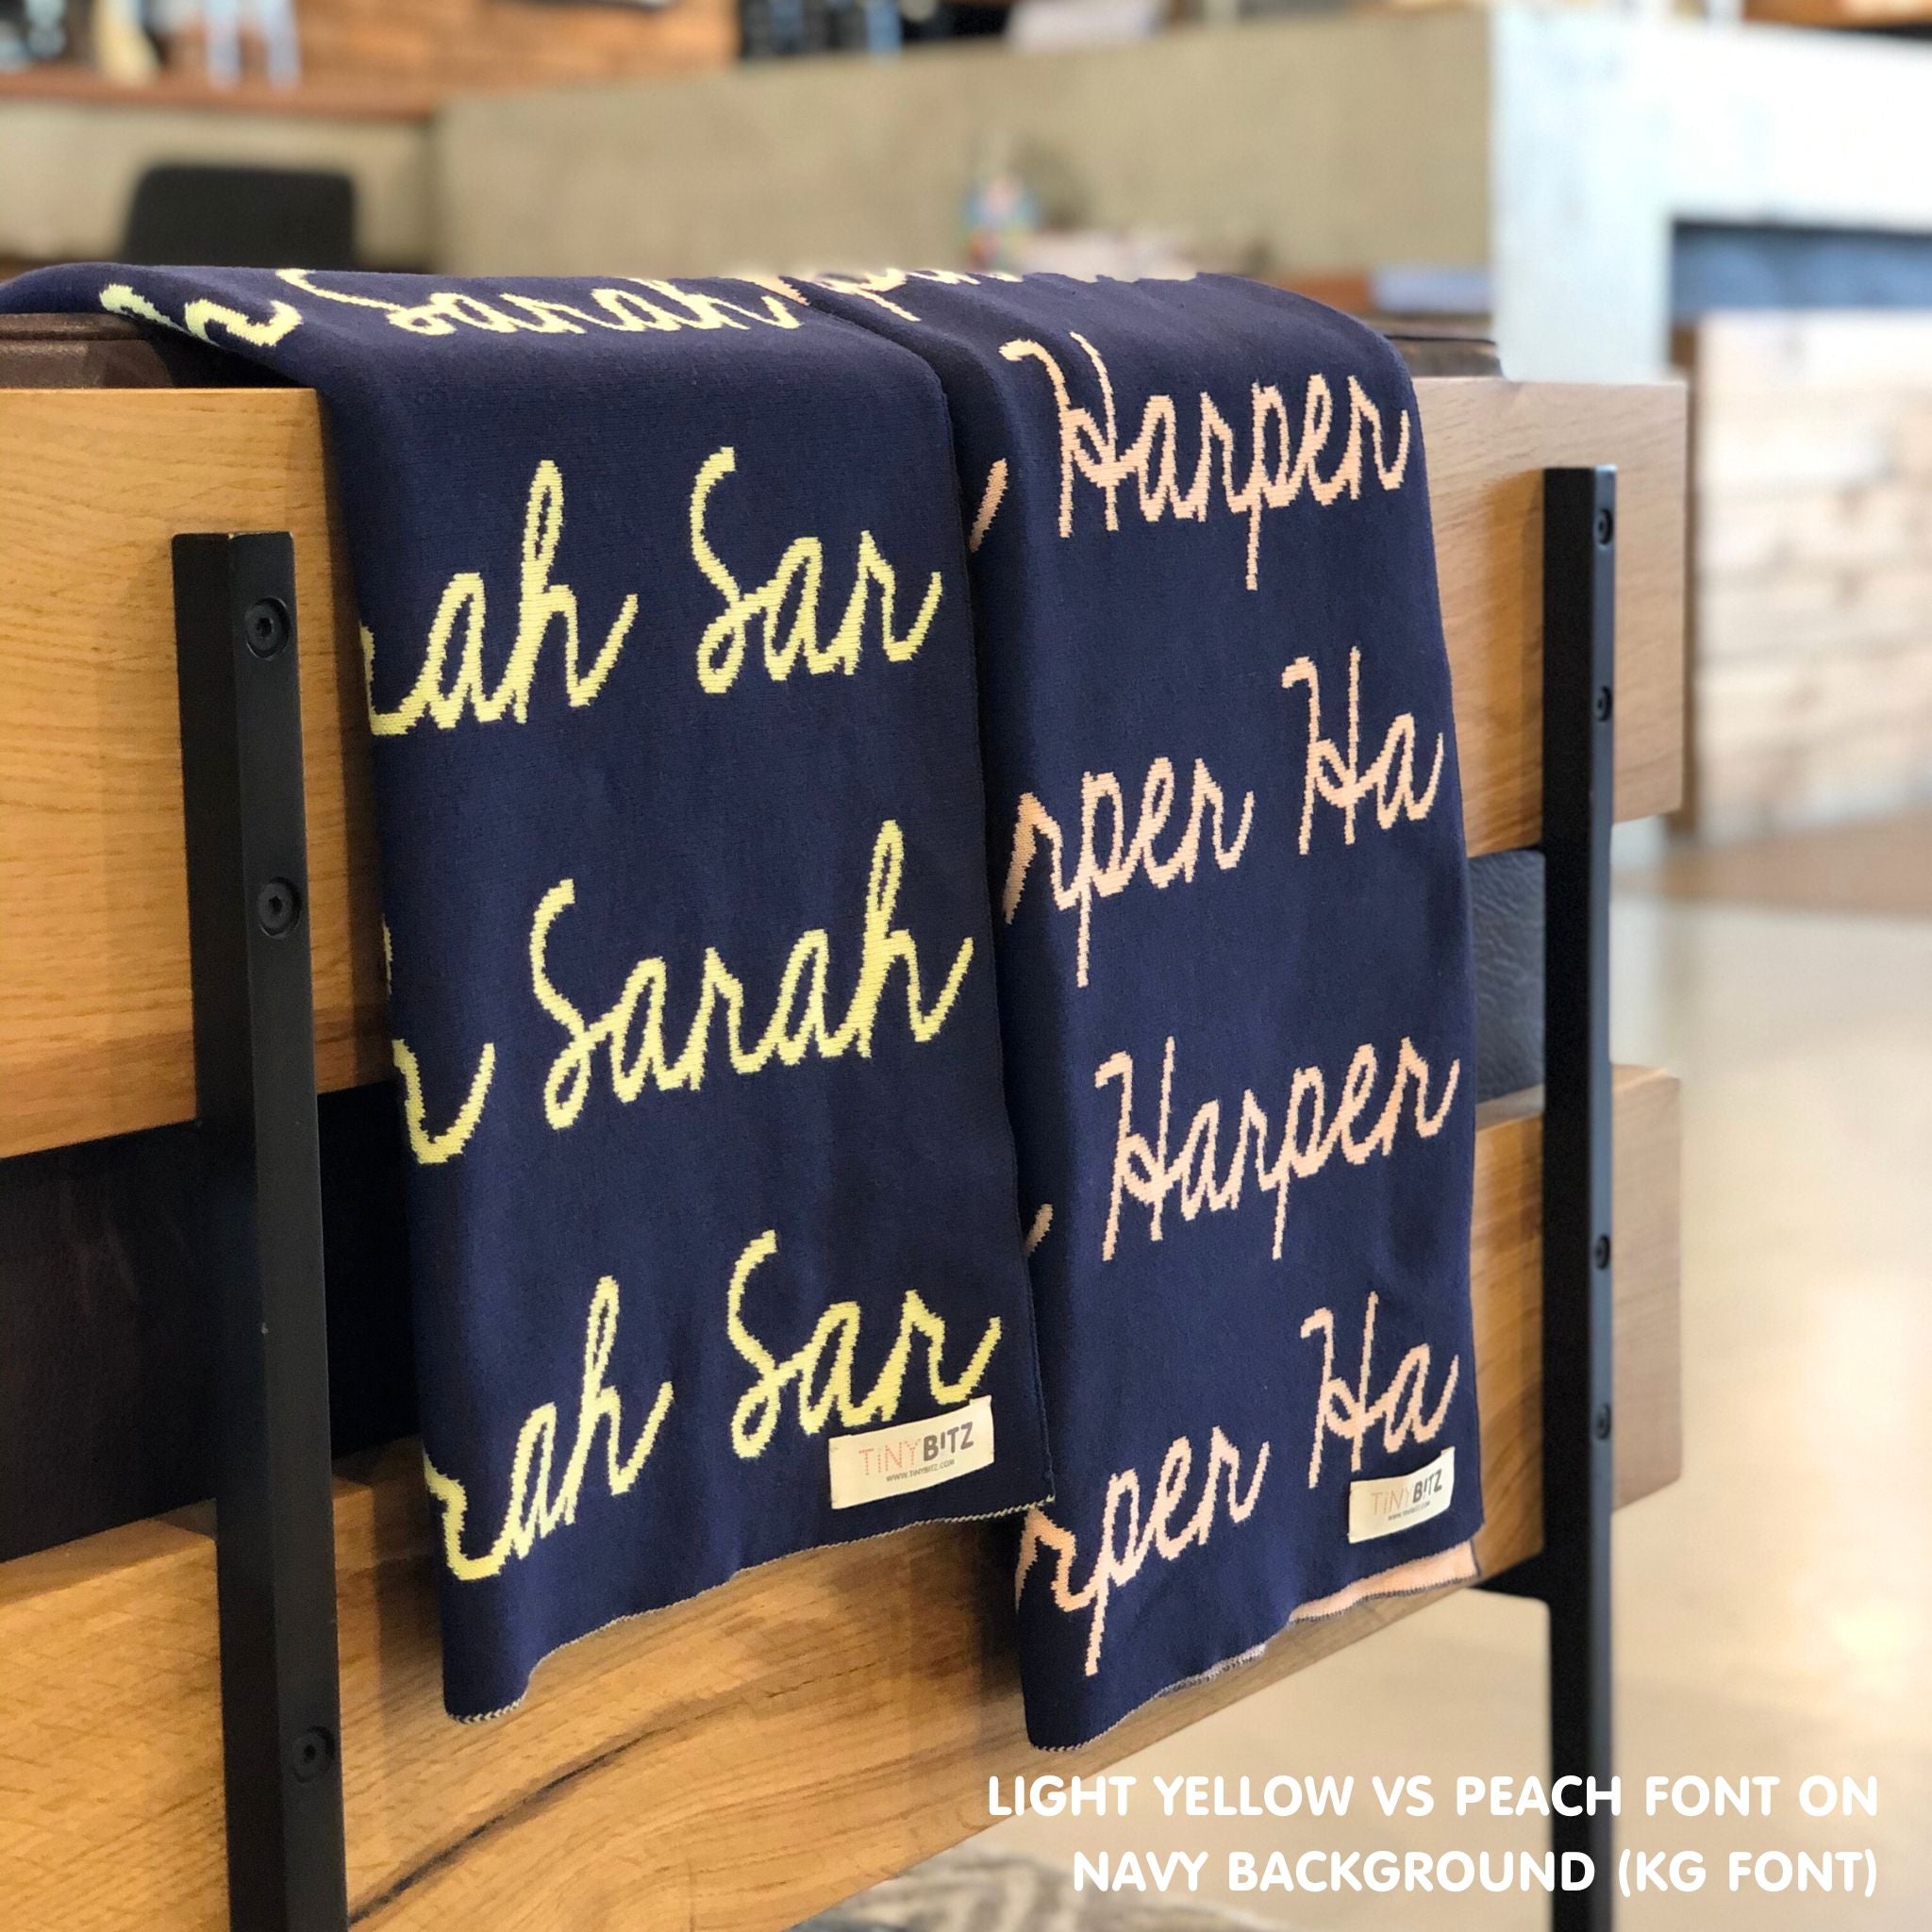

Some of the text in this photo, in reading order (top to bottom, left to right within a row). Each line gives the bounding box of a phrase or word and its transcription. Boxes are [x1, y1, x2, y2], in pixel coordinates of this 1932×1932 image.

[690, 447, 943, 694] Sar
[1000, 331, 1409, 591] Harper
[1282, 646, 1444, 856] Ha
[528, 820, 974, 1131] Sarah
[1094, 1036, 1460, 1262] Harper
[727, 1229, 1002, 1458] Sar
[1301, 1291, 1459, 1489] Ha
